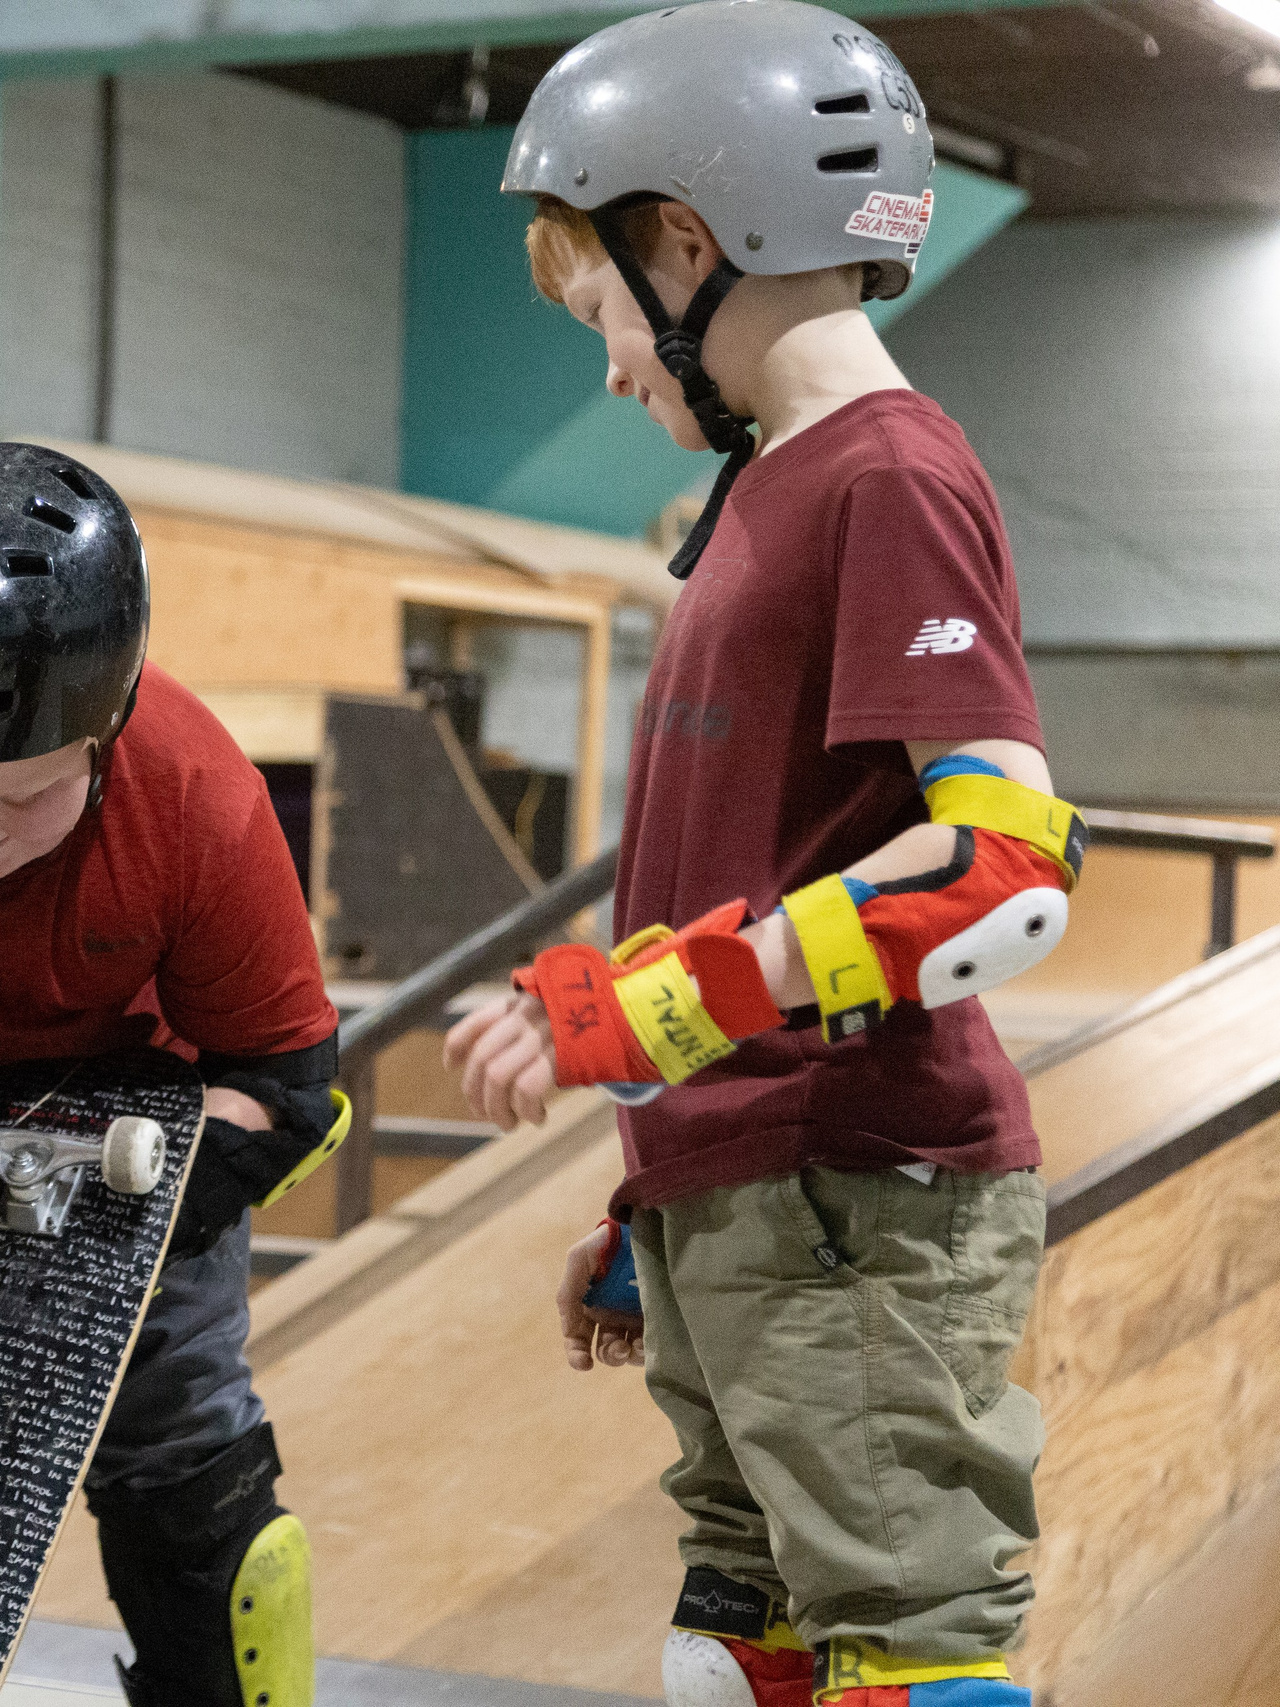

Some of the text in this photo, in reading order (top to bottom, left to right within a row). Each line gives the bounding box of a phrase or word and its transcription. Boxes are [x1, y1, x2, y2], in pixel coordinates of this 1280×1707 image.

[866, 194, 921, 220] CINEMA
[848, 213, 923, 239] SKATEPARK
[93, 1311, 123, 1325] NOT
[20, 1357, 37, 1369] IN
[66, 1352, 84, 1364] IN
[24, 1387, 51, 1399] NOT
[16, 1428, 48, 1442] NOT
[47, 1470, 62, 1480] IN
[11, 1539, 39, 1553] NOT
[682, 1594, 704, 1605] PRO
